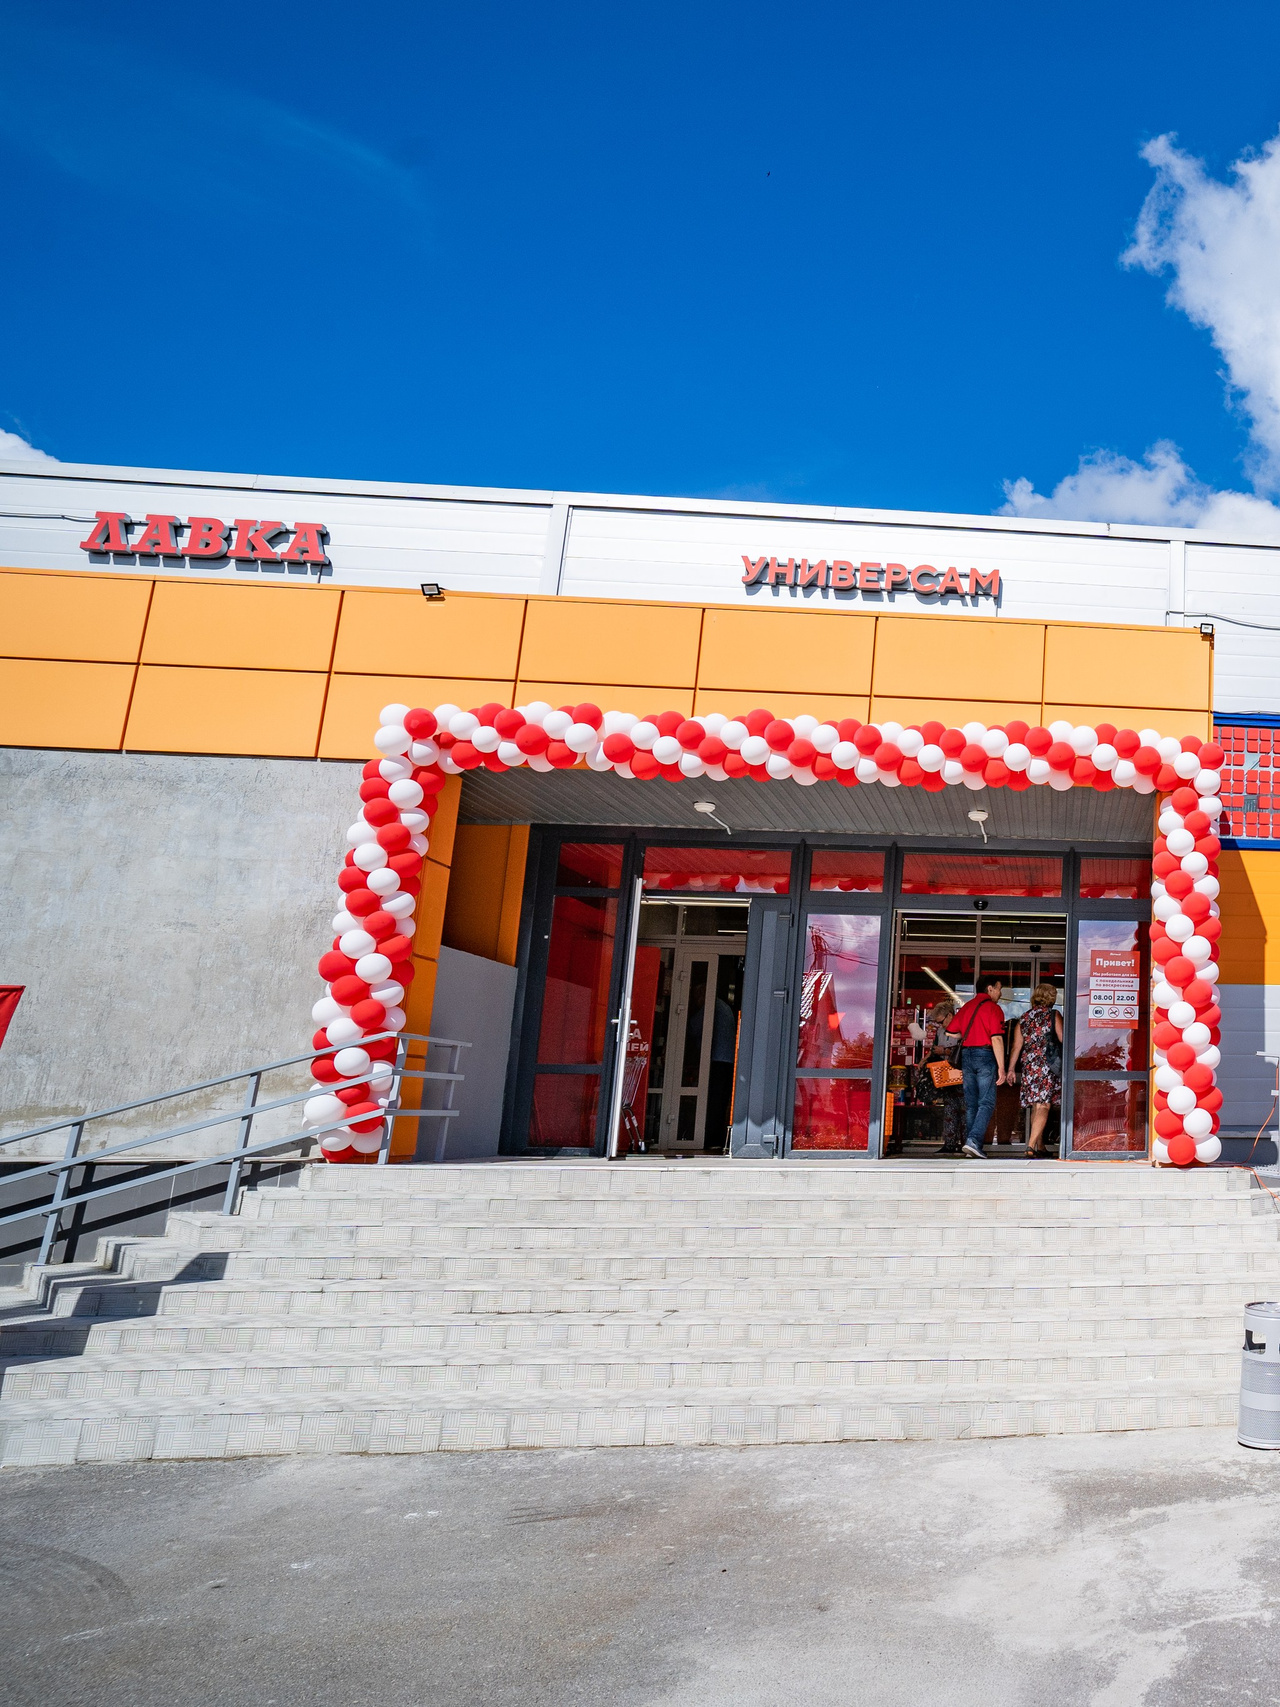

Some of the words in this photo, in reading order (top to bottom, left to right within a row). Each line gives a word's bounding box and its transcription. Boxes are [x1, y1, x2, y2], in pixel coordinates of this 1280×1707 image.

[79, 510, 328, 563] ЛАВКА
[741, 555, 1000, 597] УНИВЕРСАМ
[1096, 958, 1135, 968] Привет!
